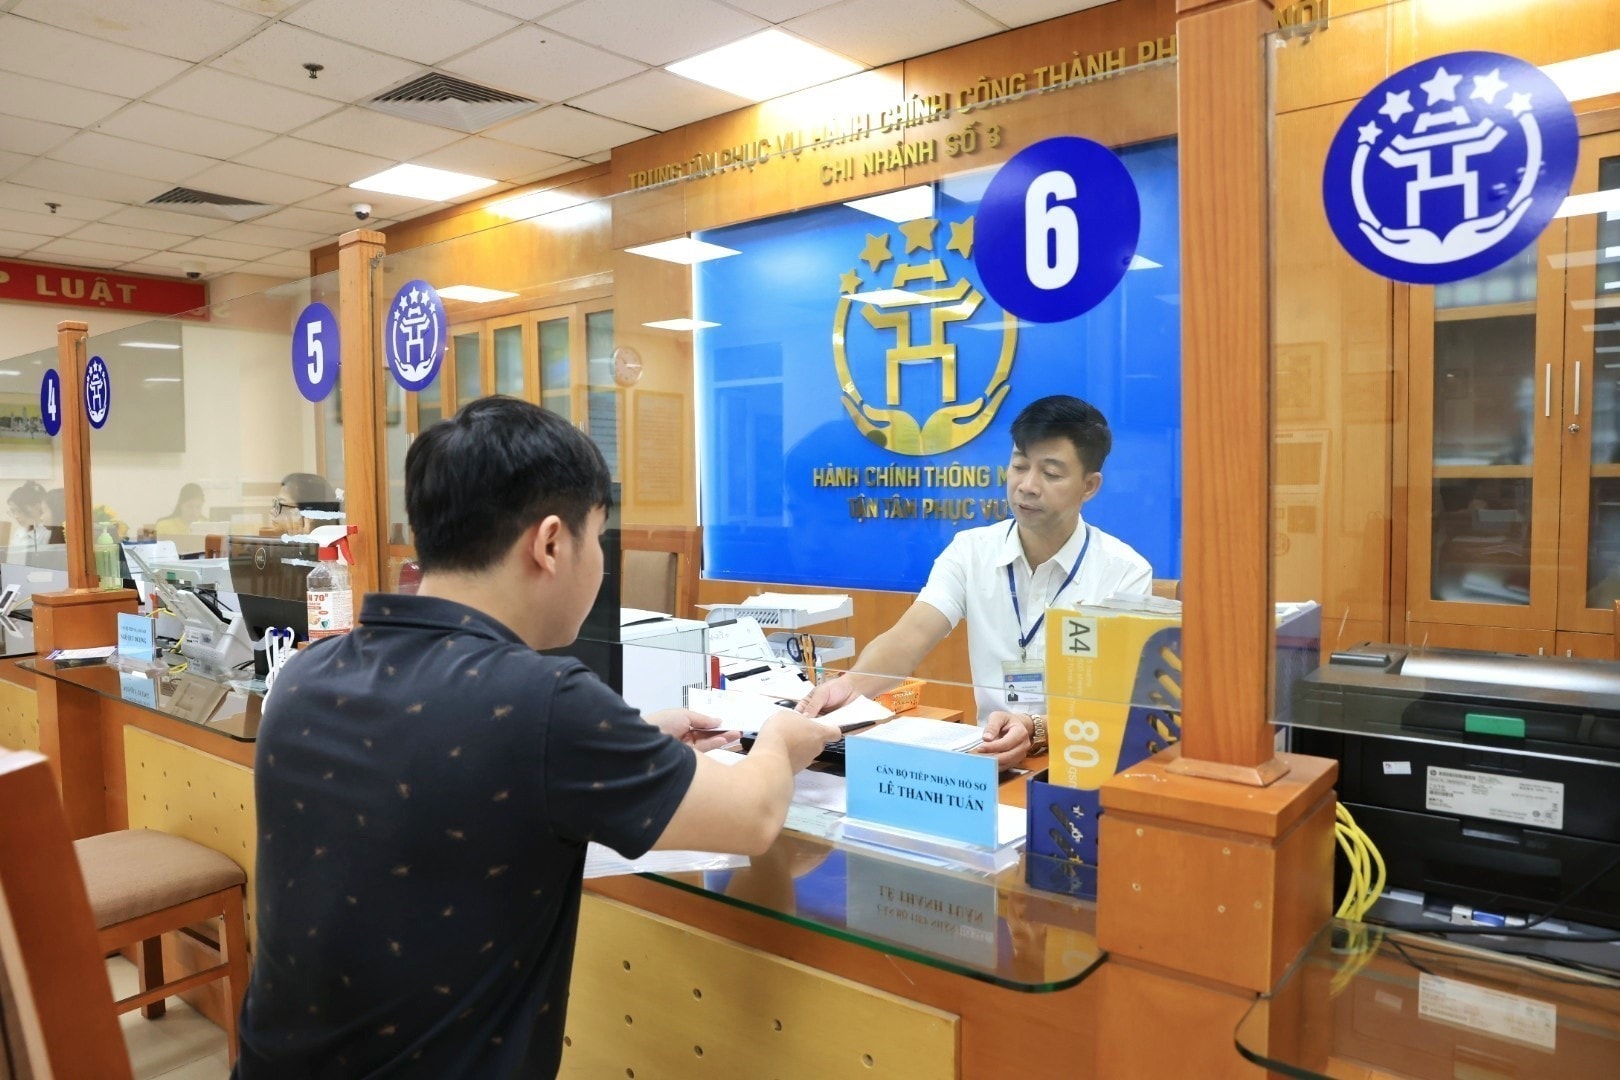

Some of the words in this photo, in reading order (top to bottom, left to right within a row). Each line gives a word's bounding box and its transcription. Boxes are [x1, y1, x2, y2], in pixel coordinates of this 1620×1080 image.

[628, 163, 682, 191] TRUNG
[720, 138, 771, 174] PHỤC
[881, 92, 950, 133] CHÍNH
[957, 72, 1026, 114] CÔNG
[1033, 47, 1126, 94] THÀNH
[820, 157, 854, 184] CHI
[863, 139, 937, 176] NHÁNH
[946, 120, 981, 157] SỐ
[987, 124, 1001, 148] 3
[1025, 170, 1079, 290] 6
[36, 274, 137, 306] LUẬT
[307, 320, 324, 385] 5
[48, 379, 56, 421] 4
[813, 462, 860, 487] HÀNH
[865, 462, 920, 487] CHÍNH
[924, 461, 991, 488] THÔNG
[882, 494, 918, 518] TÂM
[922, 498, 976, 525] PHỤC
[1069, 620, 1091, 653] A4
[1064, 719, 1099, 768] 80
[876, 765, 894, 775] CÁN
[896, 768, 908, 779] BỘ
[974, 782, 987, 791] SƠ
[879, 780, 895, 795] LÊ
[897, 785, 943, 804] THANH
